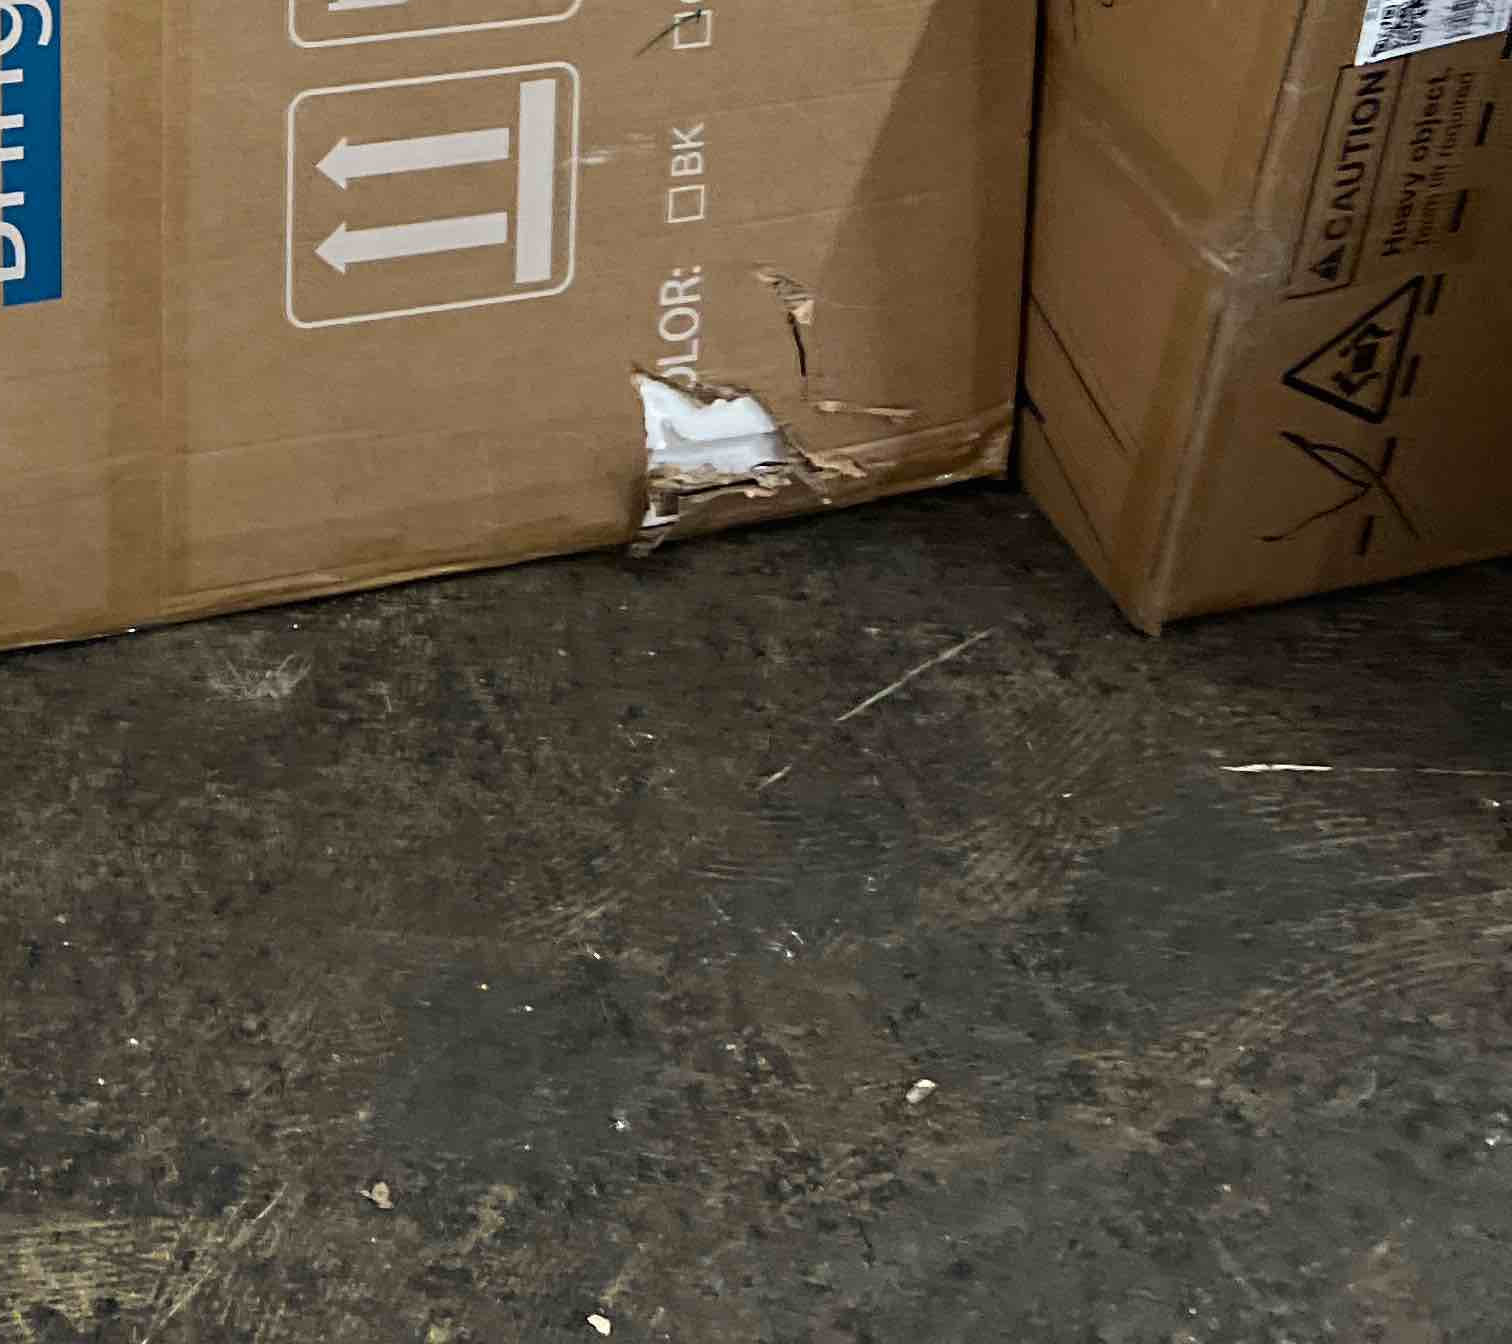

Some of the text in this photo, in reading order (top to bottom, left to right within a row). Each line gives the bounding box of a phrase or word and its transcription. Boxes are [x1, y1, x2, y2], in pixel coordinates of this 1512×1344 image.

[670, 122, 705, 178] BK
[1324, 69, 1389, 241] CAUTION
[1382, 172, 1425, 256] Heavy
[656, 264, 703, 389] OLOR:
